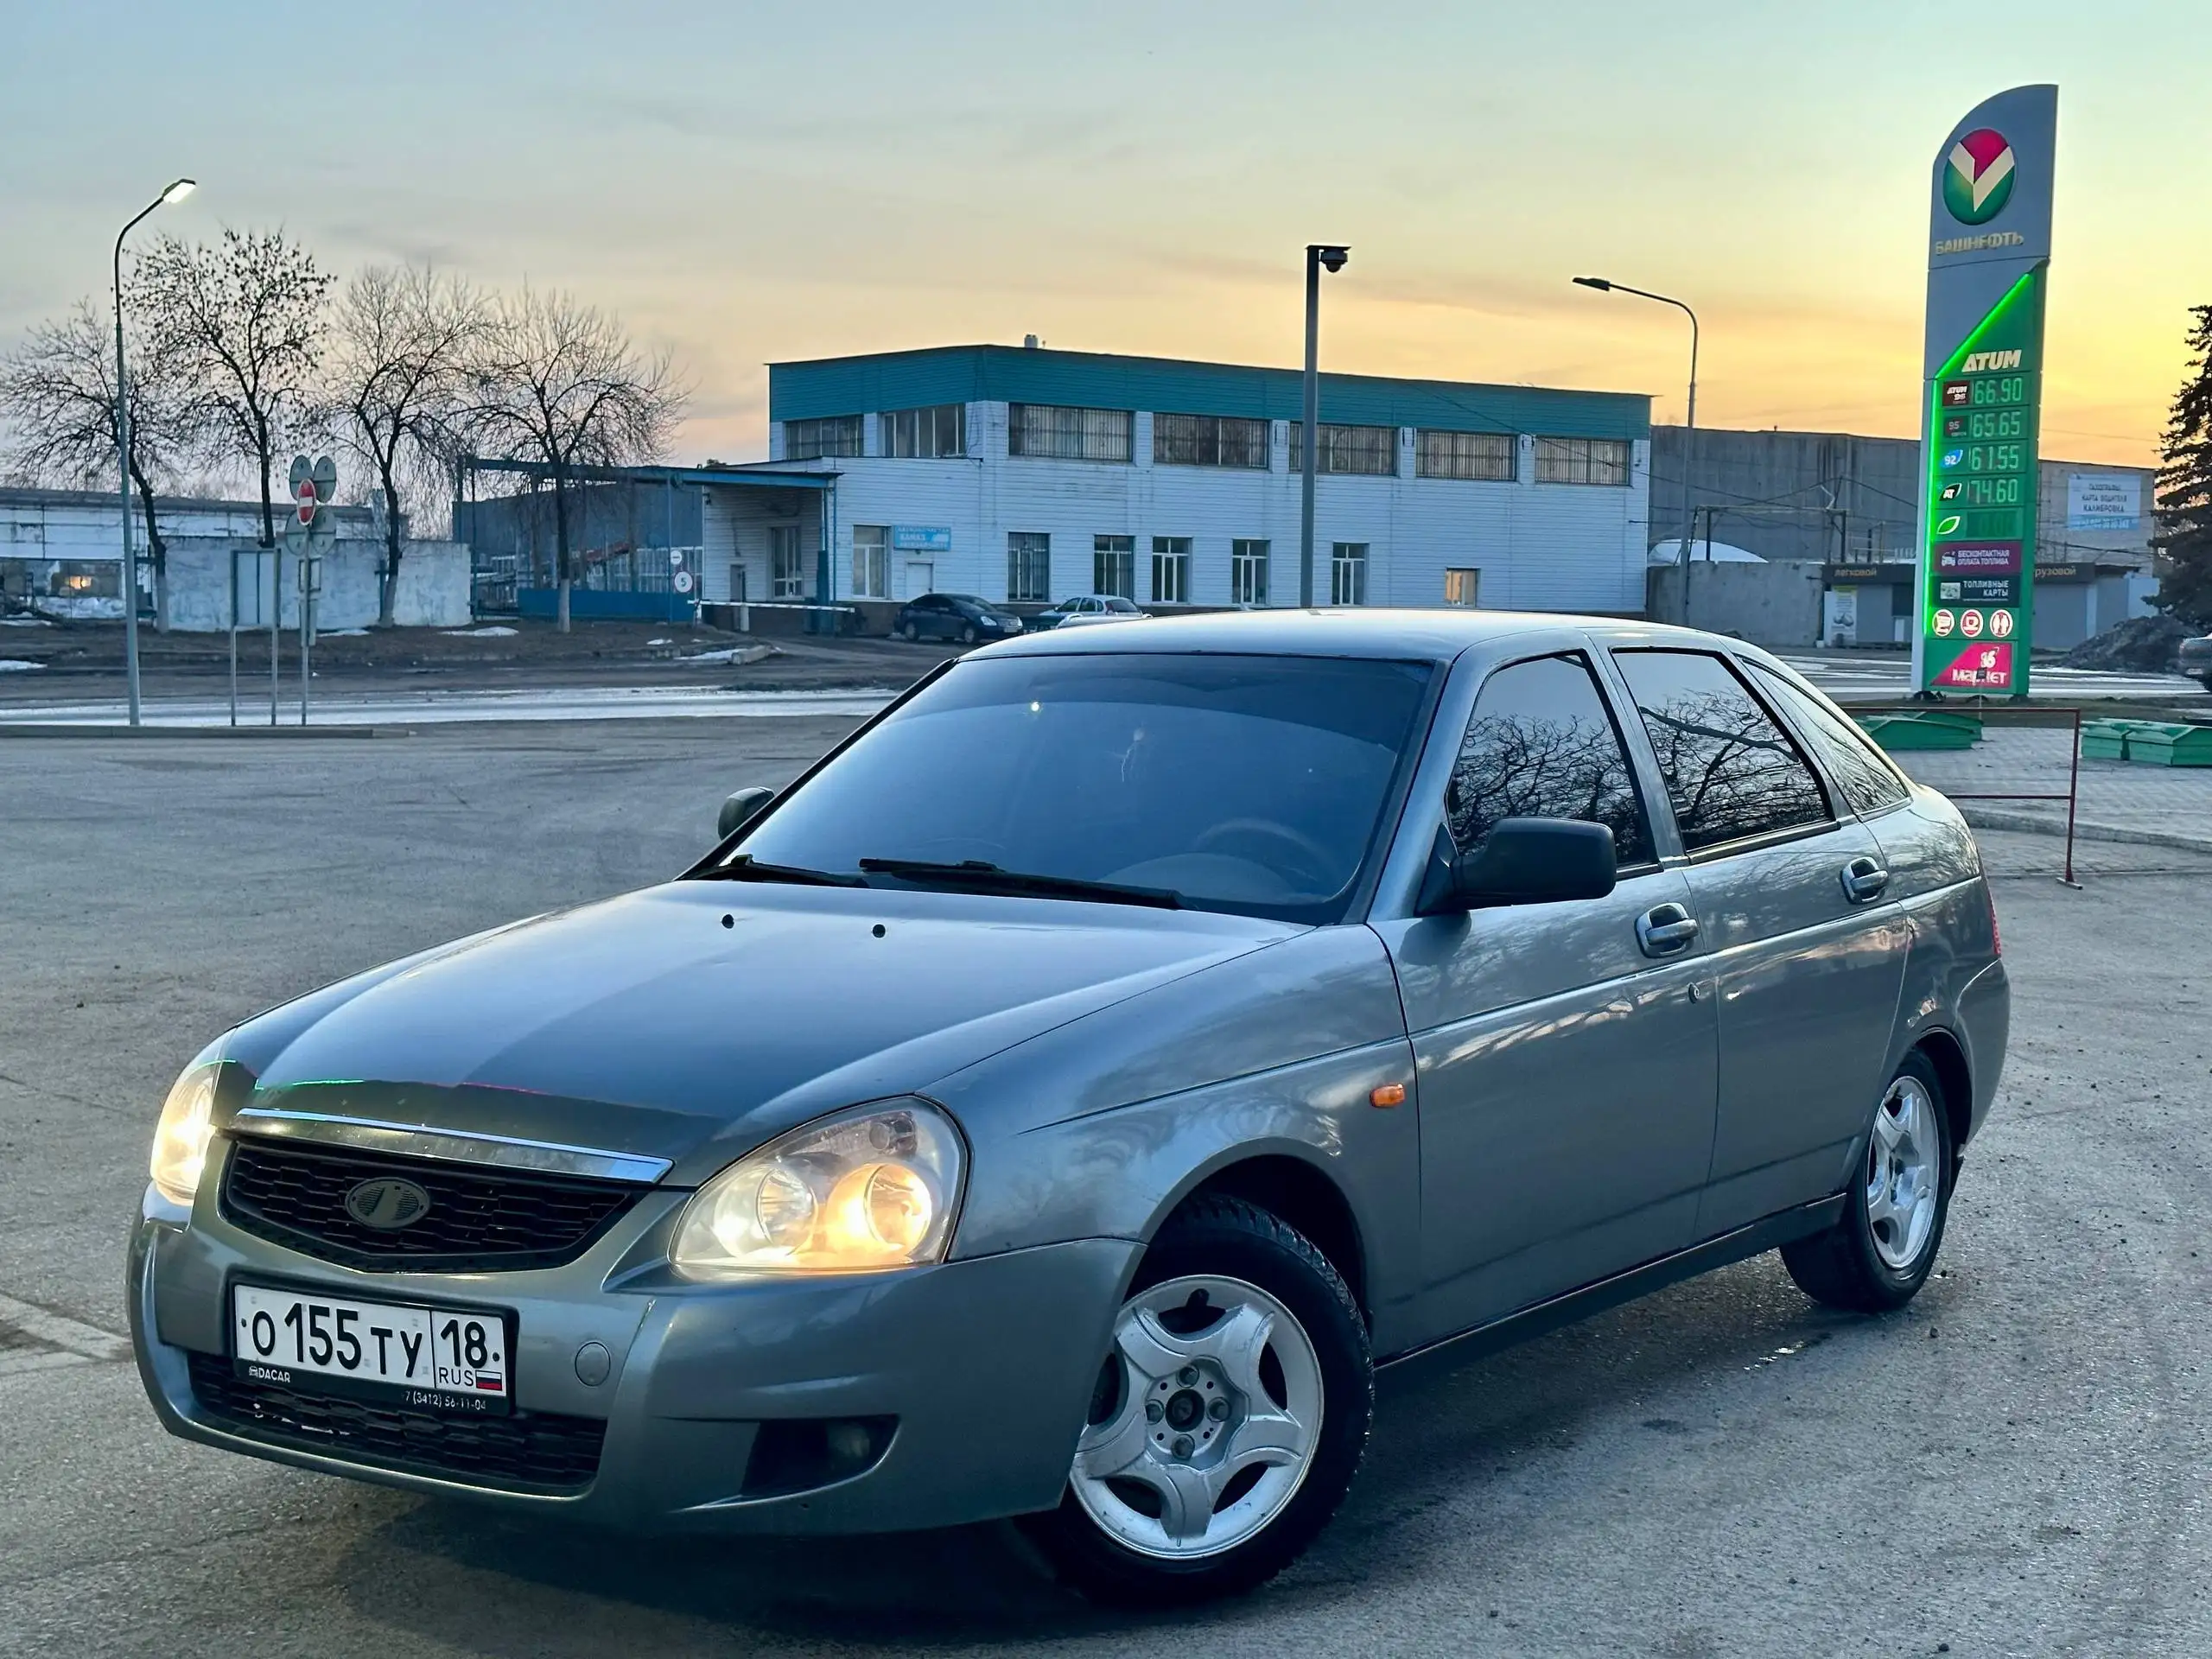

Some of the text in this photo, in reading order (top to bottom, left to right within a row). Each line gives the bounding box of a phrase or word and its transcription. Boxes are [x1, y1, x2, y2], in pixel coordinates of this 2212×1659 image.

[1936, 232, 2024, 256] БАШНЕФТЬ
[1961, 349, 2022, 372] ATUM
[1947, 385, 1967, 395] ATUM
[1974, 378, 2022, 404] 66.90
[1948, 421, 1961, 430] 95
[1944, 454, 1956, 466] 92
[1970, 478, 2018, 505] 74.60
[1957, 549, 2010, 558] БЕСКОНТАКТНАЯ
[2035, 565, 2076, 578] рузовой
[681, 577, 687, 588] 5
[1962, 580, 2010, 588] ТОПЛИВНЫЕ
[1983, 588, 2009, 597] КАРТЫ
[441, 1319, 488, 1369] 18
[258, 1367, 291, 1383] DACAR
[438, 1366, 474, 1387] RUS
[413, 1390, 442, 1408] (3412)
